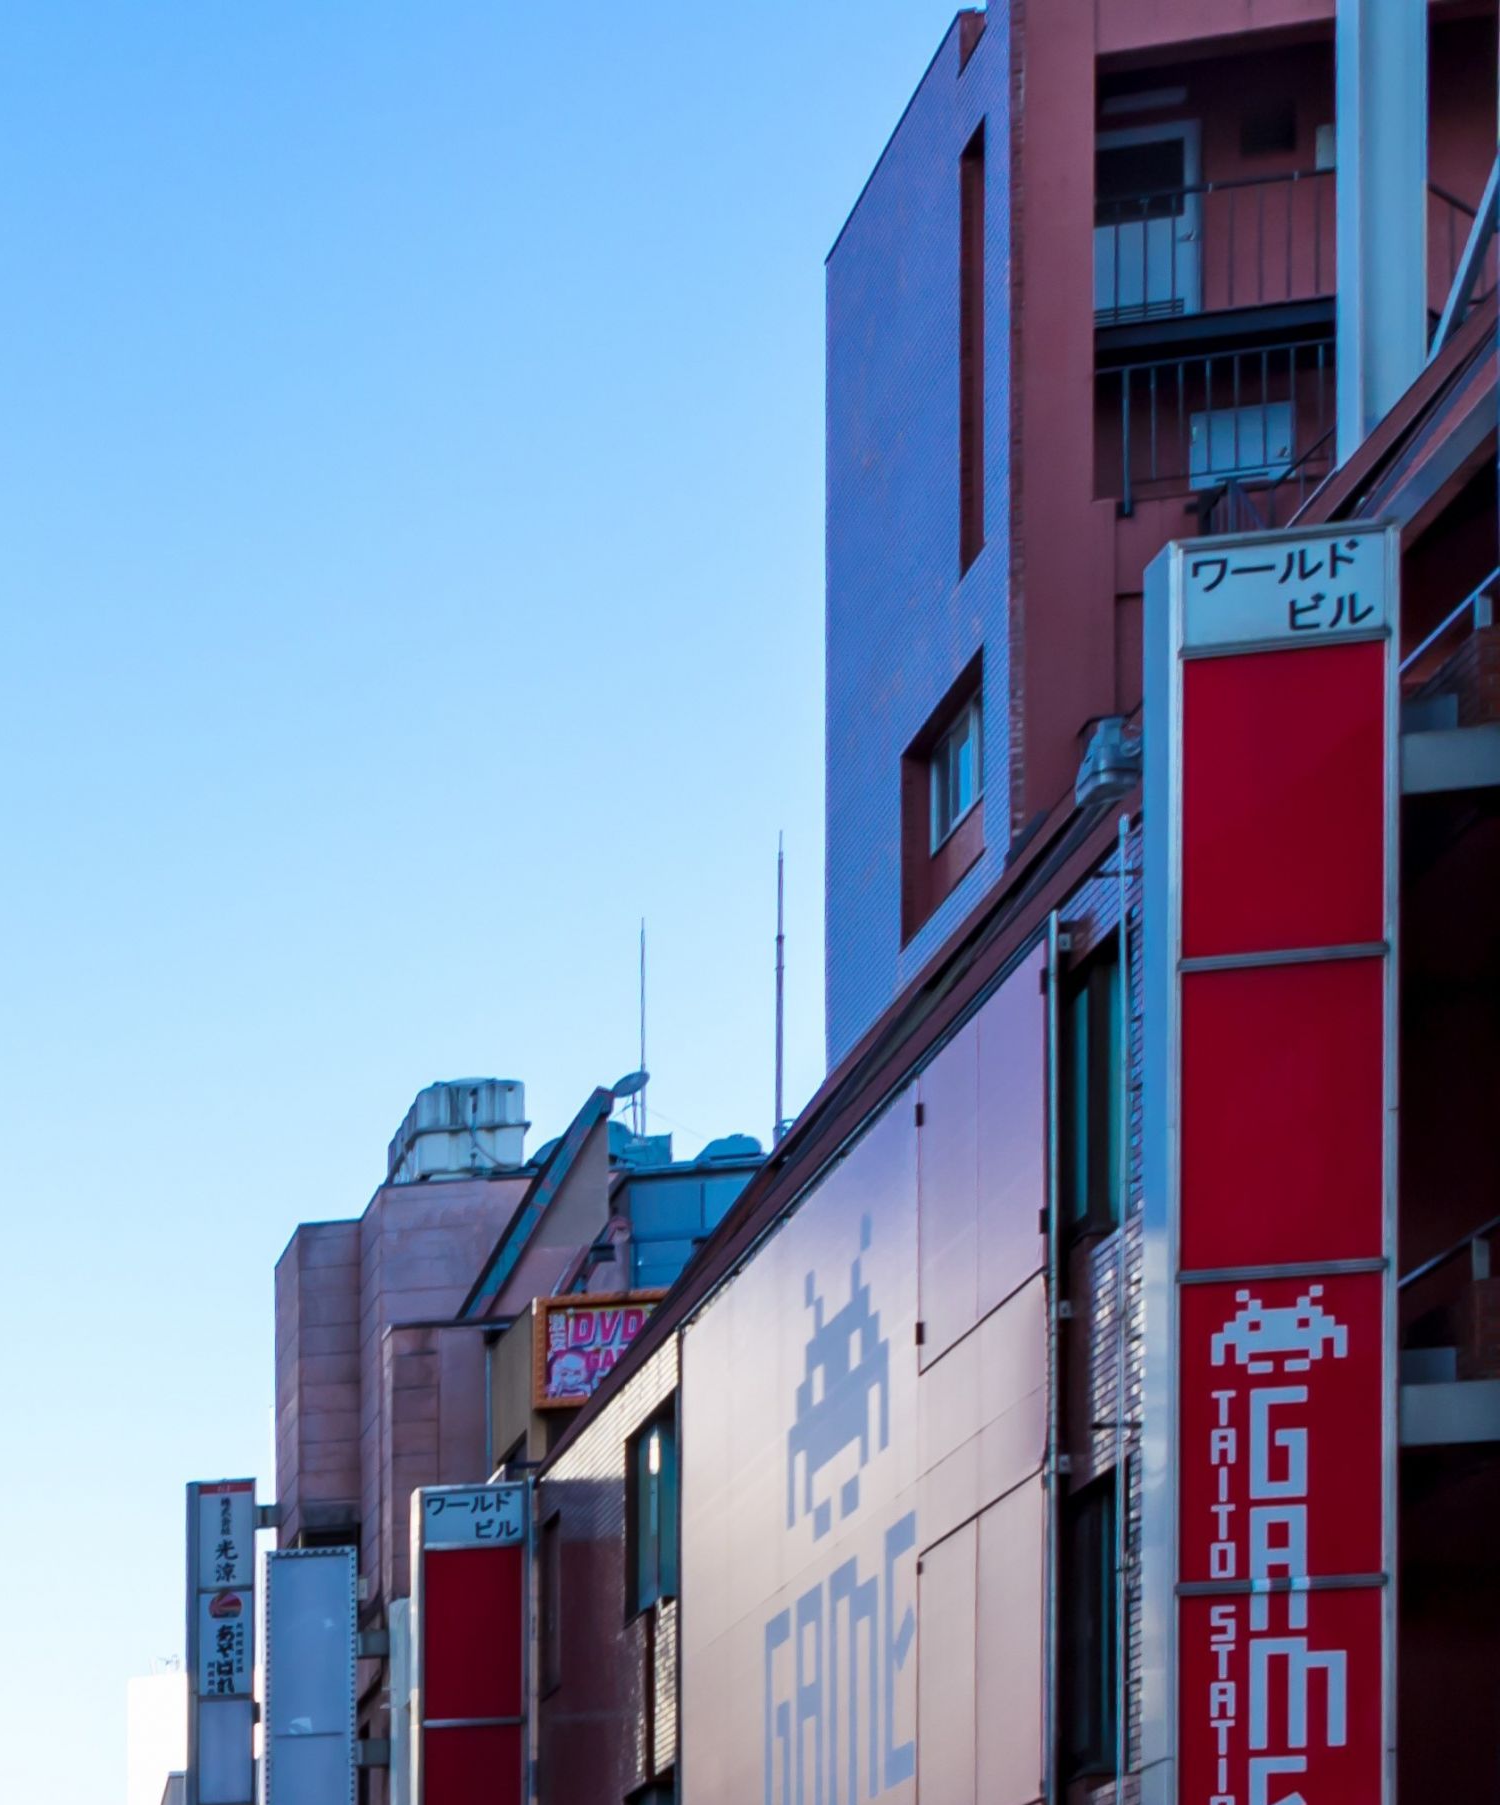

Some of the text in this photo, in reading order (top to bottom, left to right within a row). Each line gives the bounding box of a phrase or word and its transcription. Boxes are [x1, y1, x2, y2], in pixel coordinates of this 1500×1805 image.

[1191, 538, 1358, 592] ワールド
[1288, 591, 1375, 631] ビル
[426, 1491, 512, 1515] ワールド
[1210, 1390, 1237, 1579] TAITO
[474, 1519, 517, 1538] ビル
